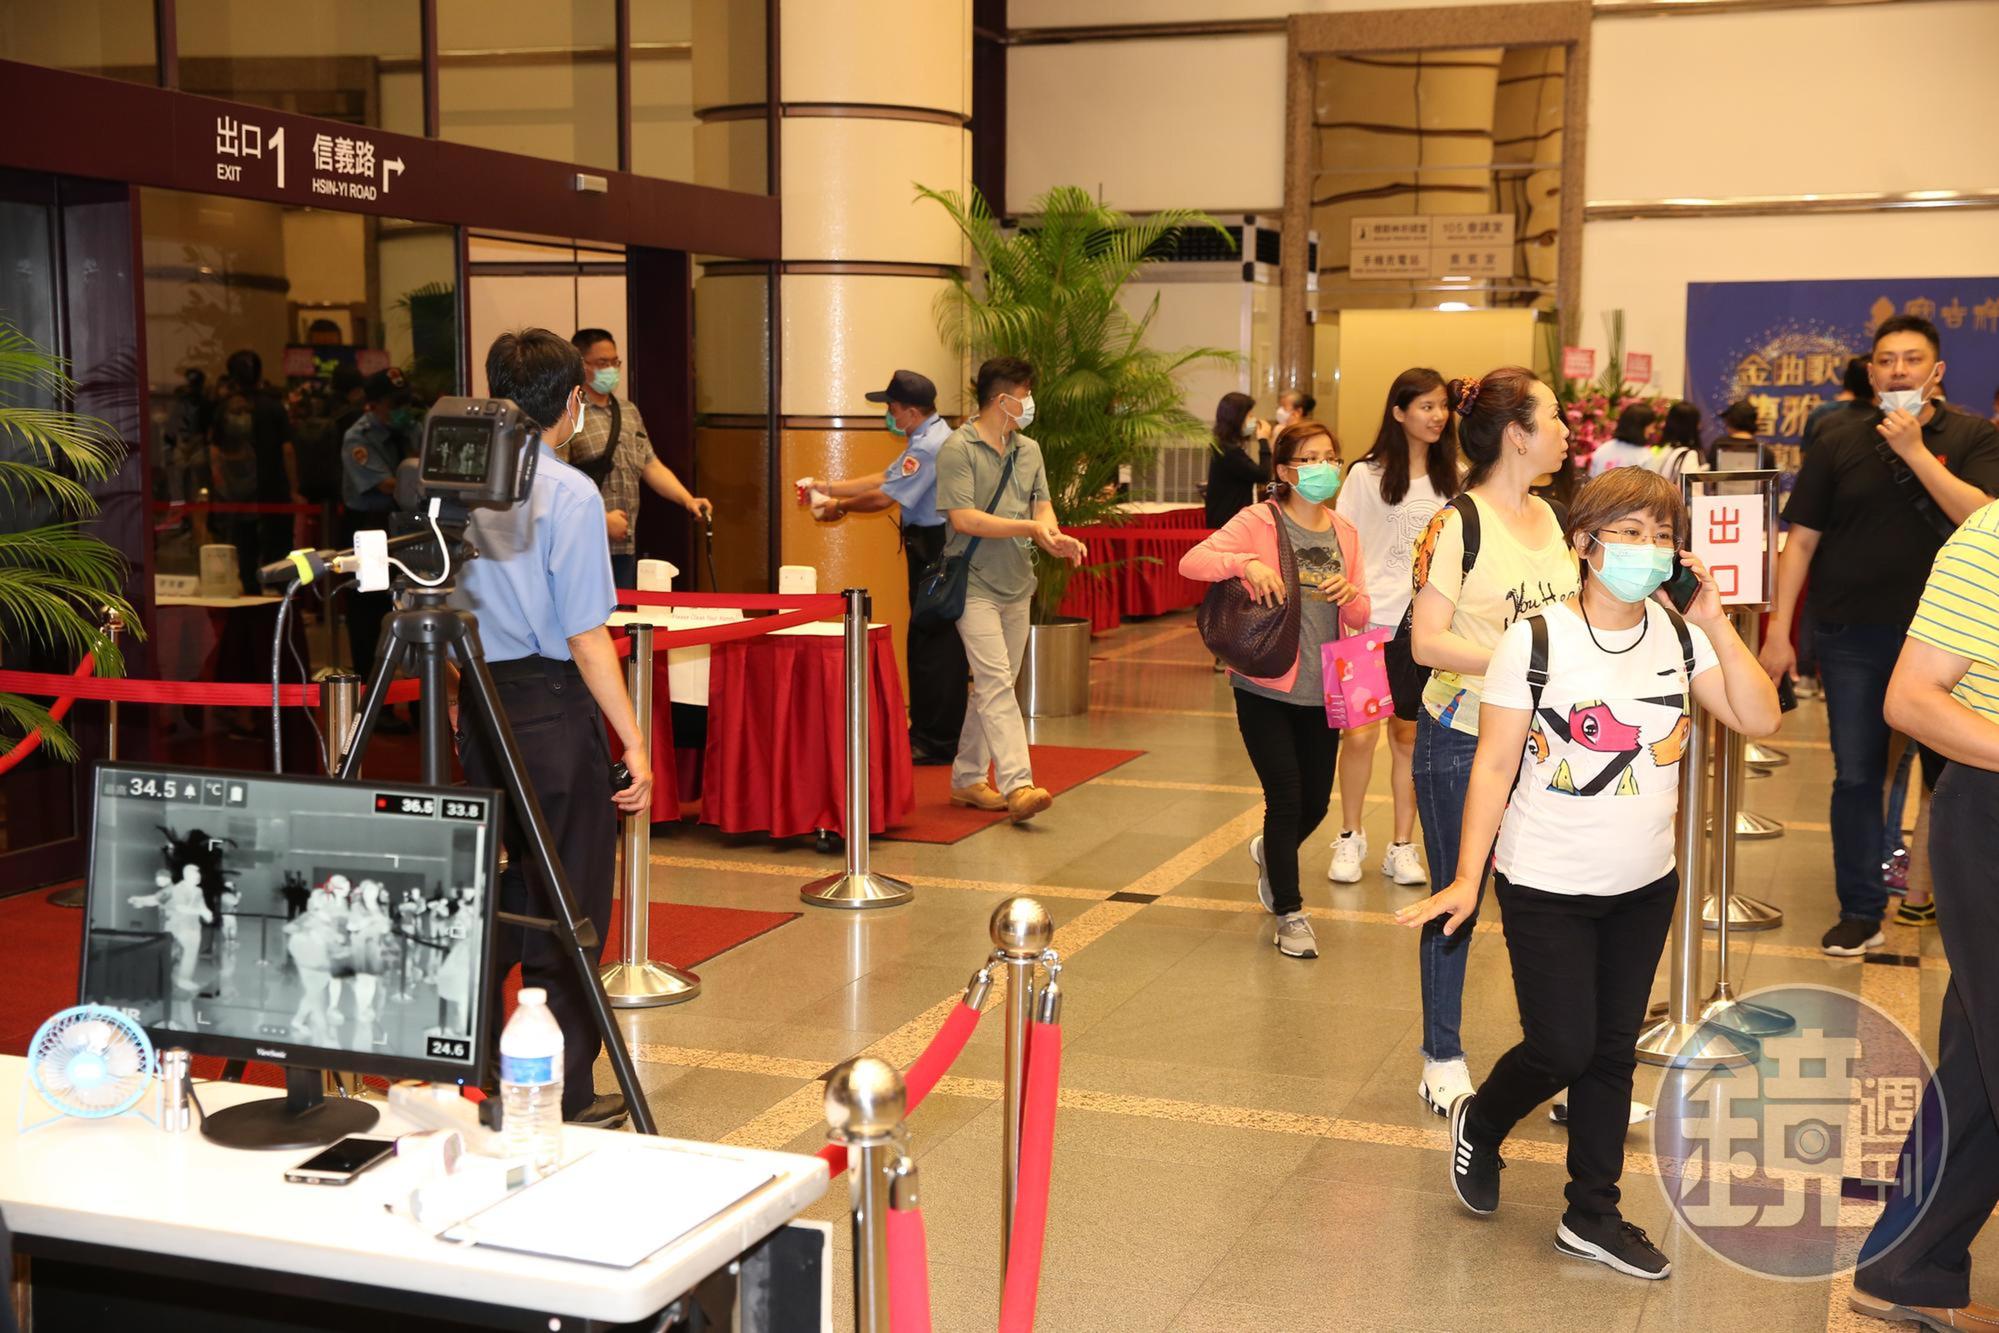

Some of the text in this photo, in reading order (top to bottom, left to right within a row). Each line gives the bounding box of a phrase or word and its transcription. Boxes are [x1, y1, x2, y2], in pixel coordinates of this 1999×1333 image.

[216, 115, 262, 160] 出口
[268, 126, 285, 189] 1
[312, 133, 376, 178] 信義路
[216, 163, 242, 182] EXIT
[312, 177, 377, 201] HSIN-YI ROAD
[1737, 352, 1852, 387] 金曲歌
[1709, 506, 1740, 597] 出口
[129, 777, 177, 798] 34.5
[401, 798, 434, 814] 36.5
[446, 802, 479, 818] 33.8
[431, 1040, 465, 1057] 24.6
